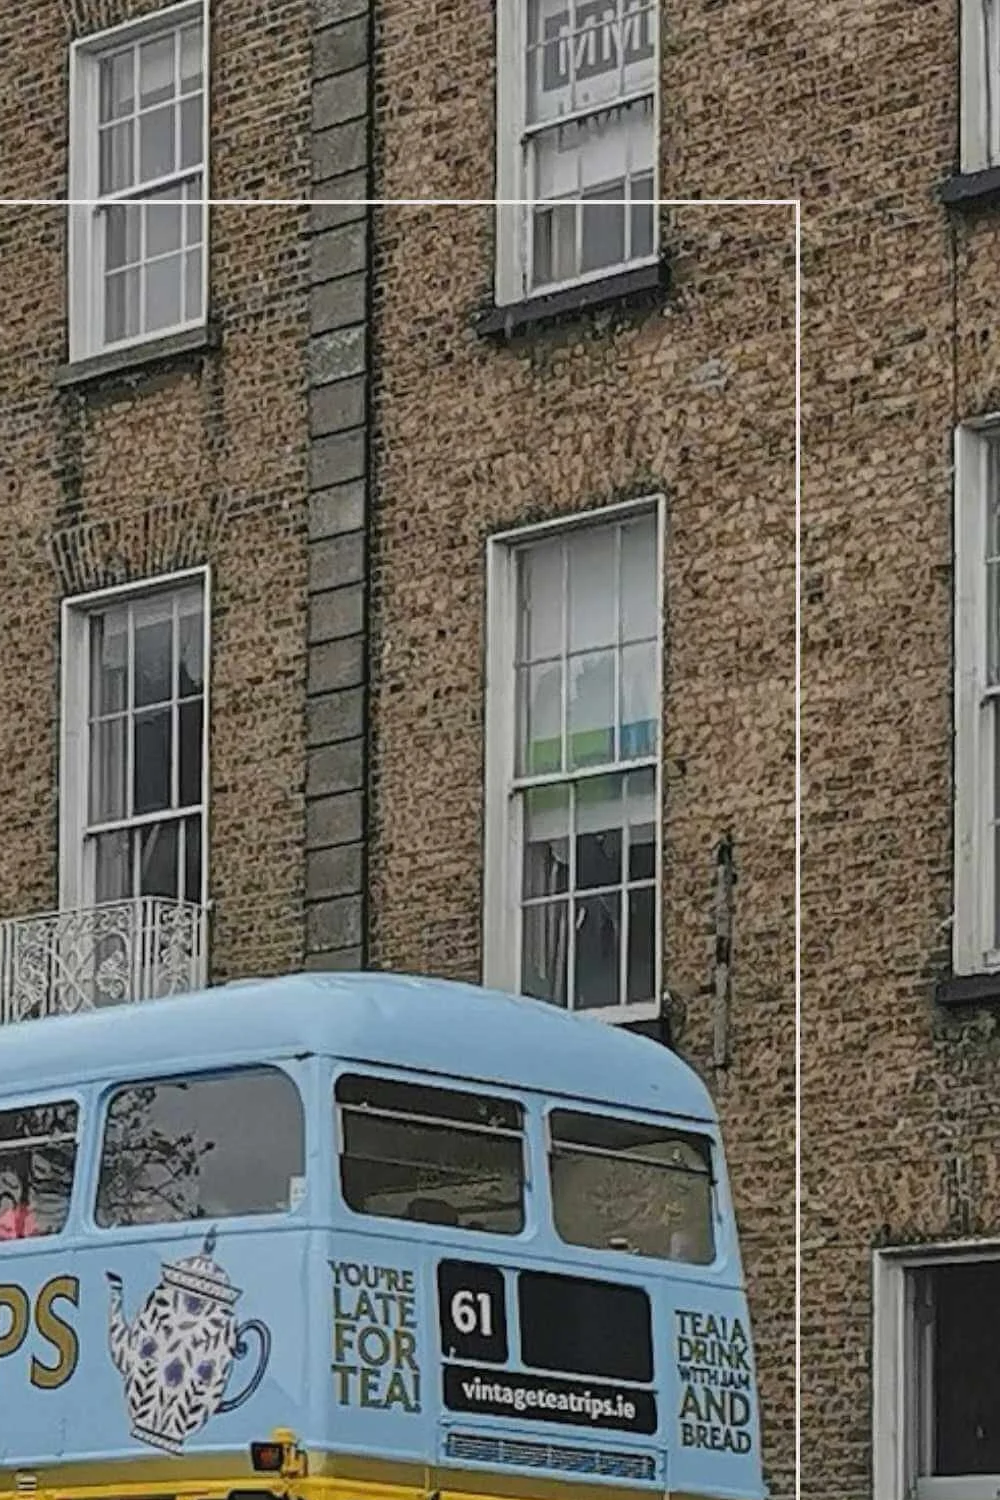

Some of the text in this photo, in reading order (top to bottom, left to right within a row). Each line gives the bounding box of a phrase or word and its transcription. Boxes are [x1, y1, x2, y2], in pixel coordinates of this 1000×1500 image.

[327, 1259, 415, 1293] YOU'RE
[333, 1286, 417, 1329] LATE
[451, 1290, 493, 1337] 61
[335, 1323, 420, 1373] FOR
[730, 1318, 748, 1345] A
[677, 1364, 719, 1386] WITH
[678, 1336, 751, 1371] DRINK
[331, 1363, 422, 1414] TEA!
[461, 1376, 636, 1420] vintageteatrips.ie
[679, 1384, 752, 1427] AND
[680, 1422, 752, 1455] BREAD
